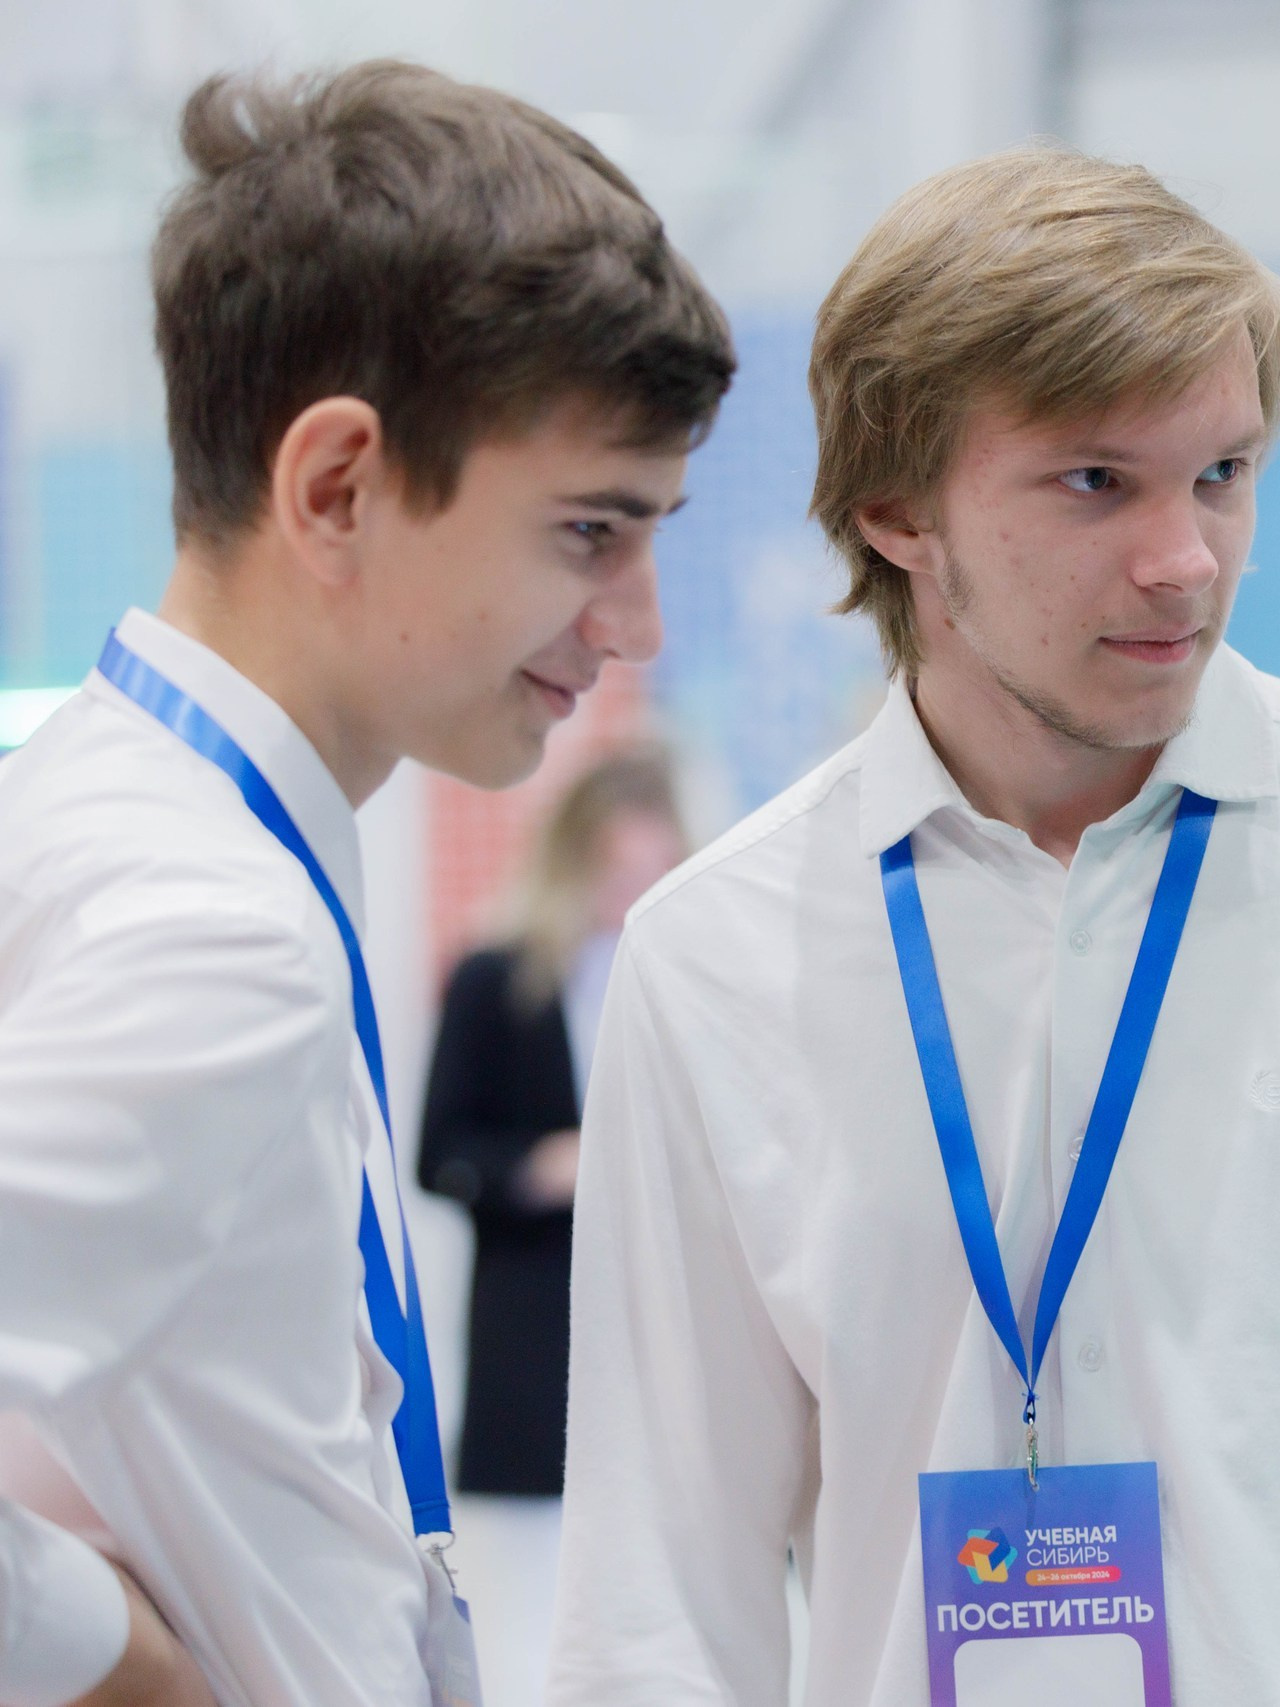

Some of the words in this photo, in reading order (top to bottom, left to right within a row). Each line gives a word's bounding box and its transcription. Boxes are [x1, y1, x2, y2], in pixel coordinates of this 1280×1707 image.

[1025, 1526, 1117, 1547] УЧЕБНАЯ
[1026, 1546, 1110, 1566] СИБИРЬ
[1061, 1572, 1091, 1581] октября
[1091, 1570, 1110, 1579] 2024
[937, 1595, 1155, 1632] ПОСЕТИТЕЛЬ
